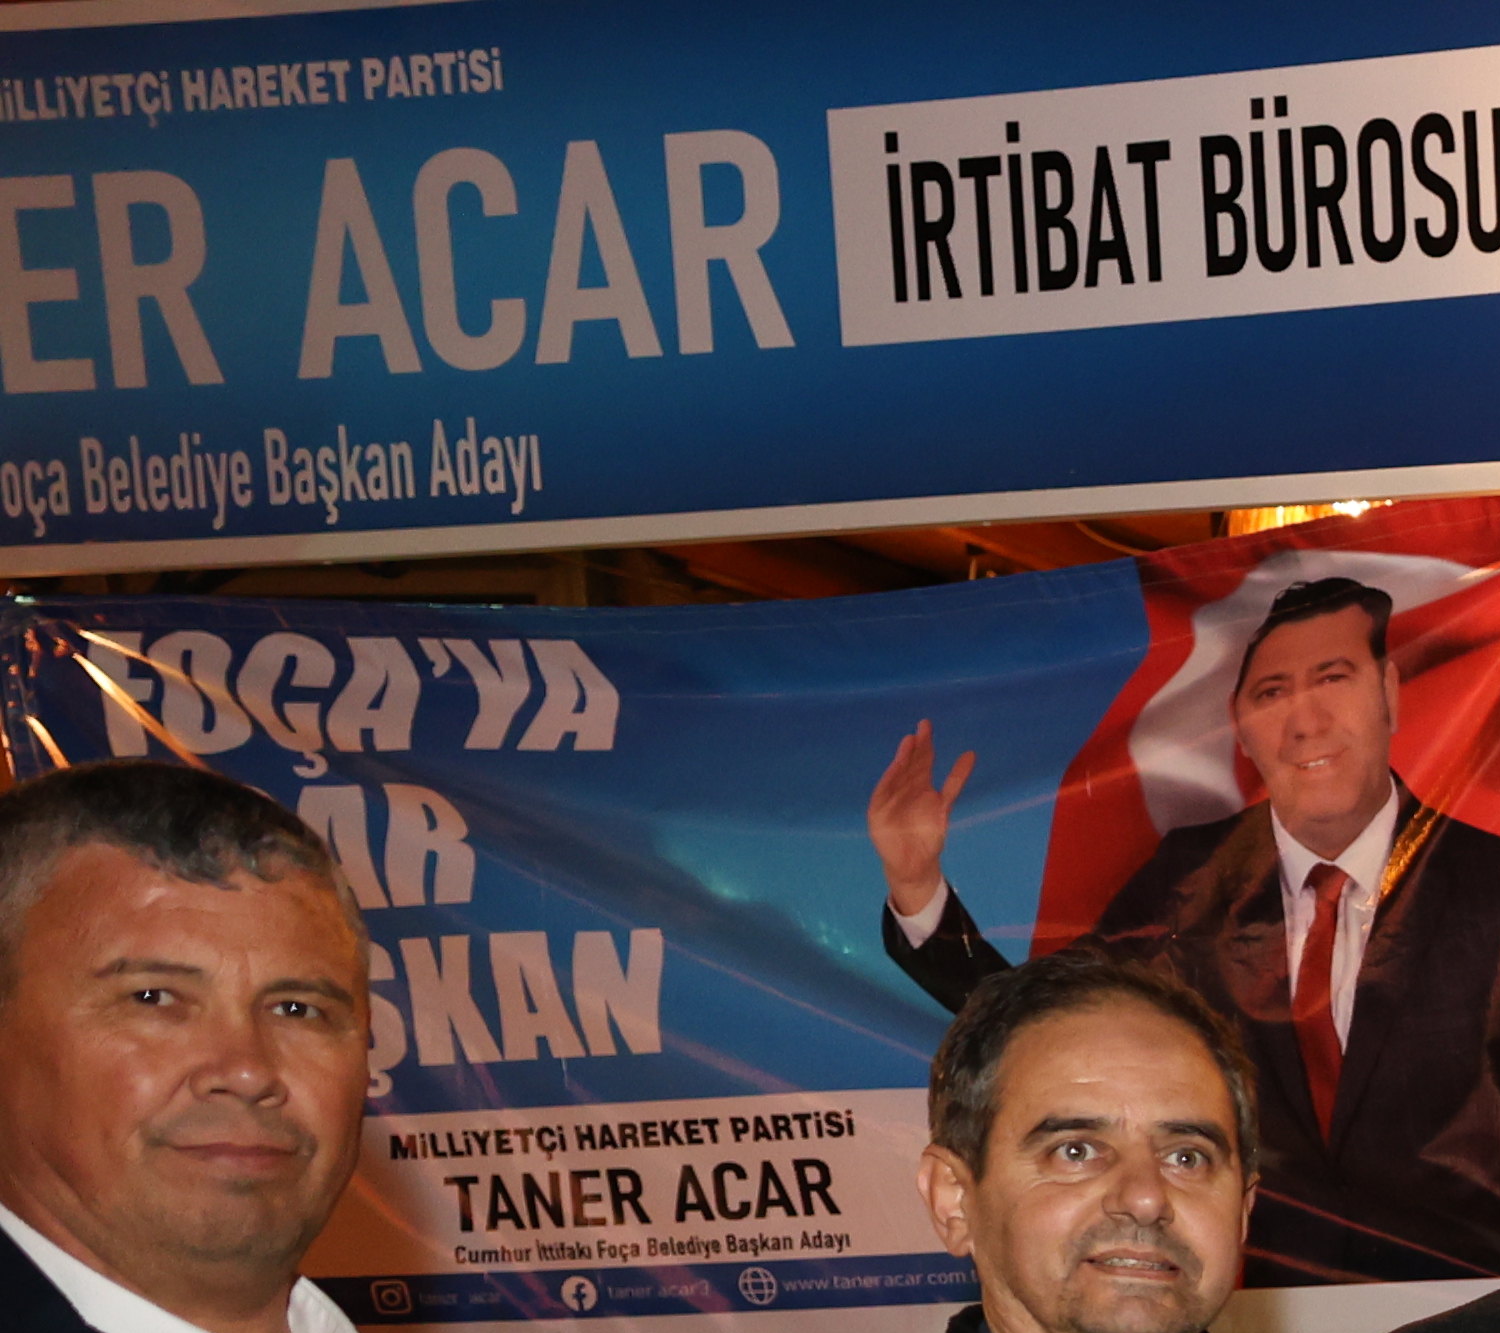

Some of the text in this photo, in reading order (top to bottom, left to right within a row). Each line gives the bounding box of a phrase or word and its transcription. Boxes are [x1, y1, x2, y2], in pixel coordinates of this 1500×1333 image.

[181, 59, 351, 112] HAREKET
[0, 128, 796, 393] ER ACAR
[884, 120, 1171, 303] İRTİBAT
[80, 431, 255, 530] Belediye
[264, 424, 416, 525] Başkan
[430, 416, 543, 515] Adayı
[87, 630, 620, 778] FOÇA'YA
[243, 783, 475, 911] AR
[575, 1117, 719, 1151] HAREKET
[443, 1157, 842, 1232] TANER ACAR
[455, 1245, 533, 1264] Cumhur
[596, 1238, 641, 1263] Foça
[646, 1234, 722, 1260] Belediye
[725, 1231, 794, 1258] Başkan
[800, 1229, 852, 1254] Adayı
